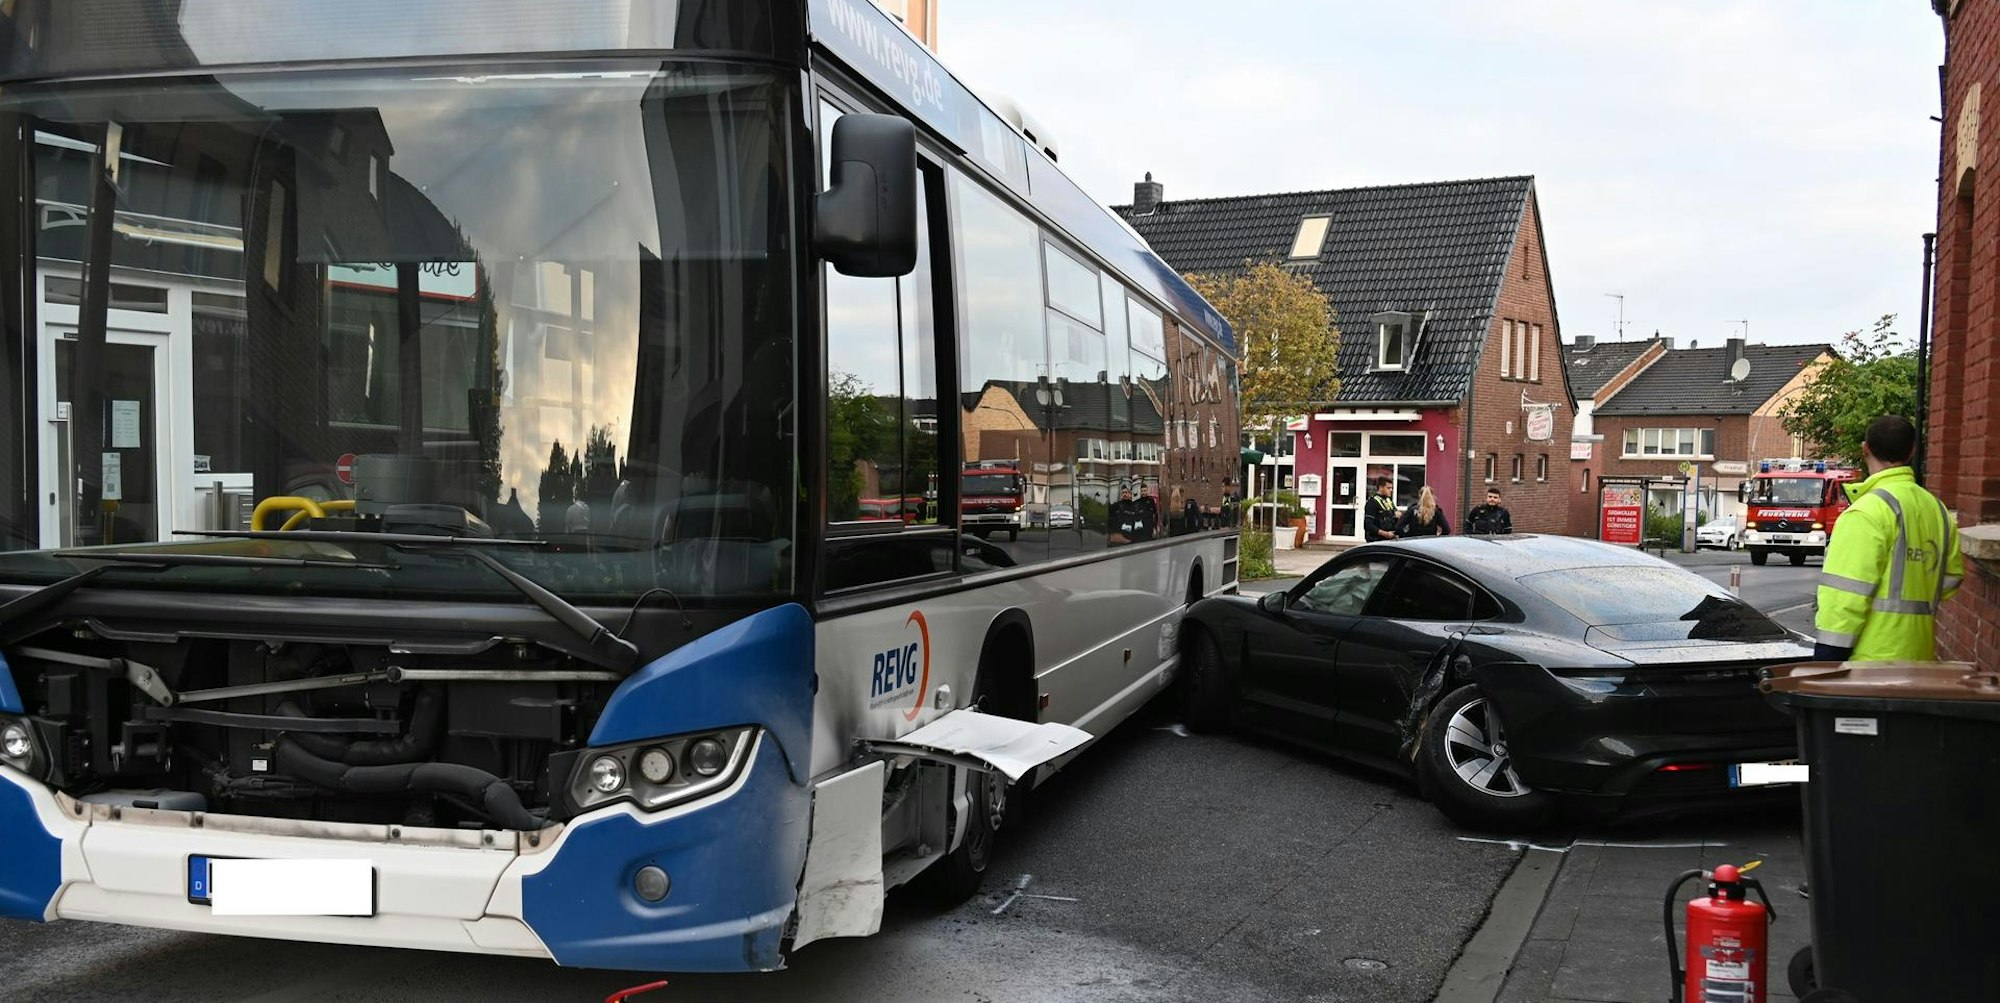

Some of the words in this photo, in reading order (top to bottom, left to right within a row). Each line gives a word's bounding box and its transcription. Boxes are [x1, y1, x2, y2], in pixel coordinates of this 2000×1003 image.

[828, 0, 944, 112] www.revg.de
[1757, 509, 1811, 518] FEUERWEHR
[871, 642, 918, 698] REVG
[195, 881, 202, 891] D
